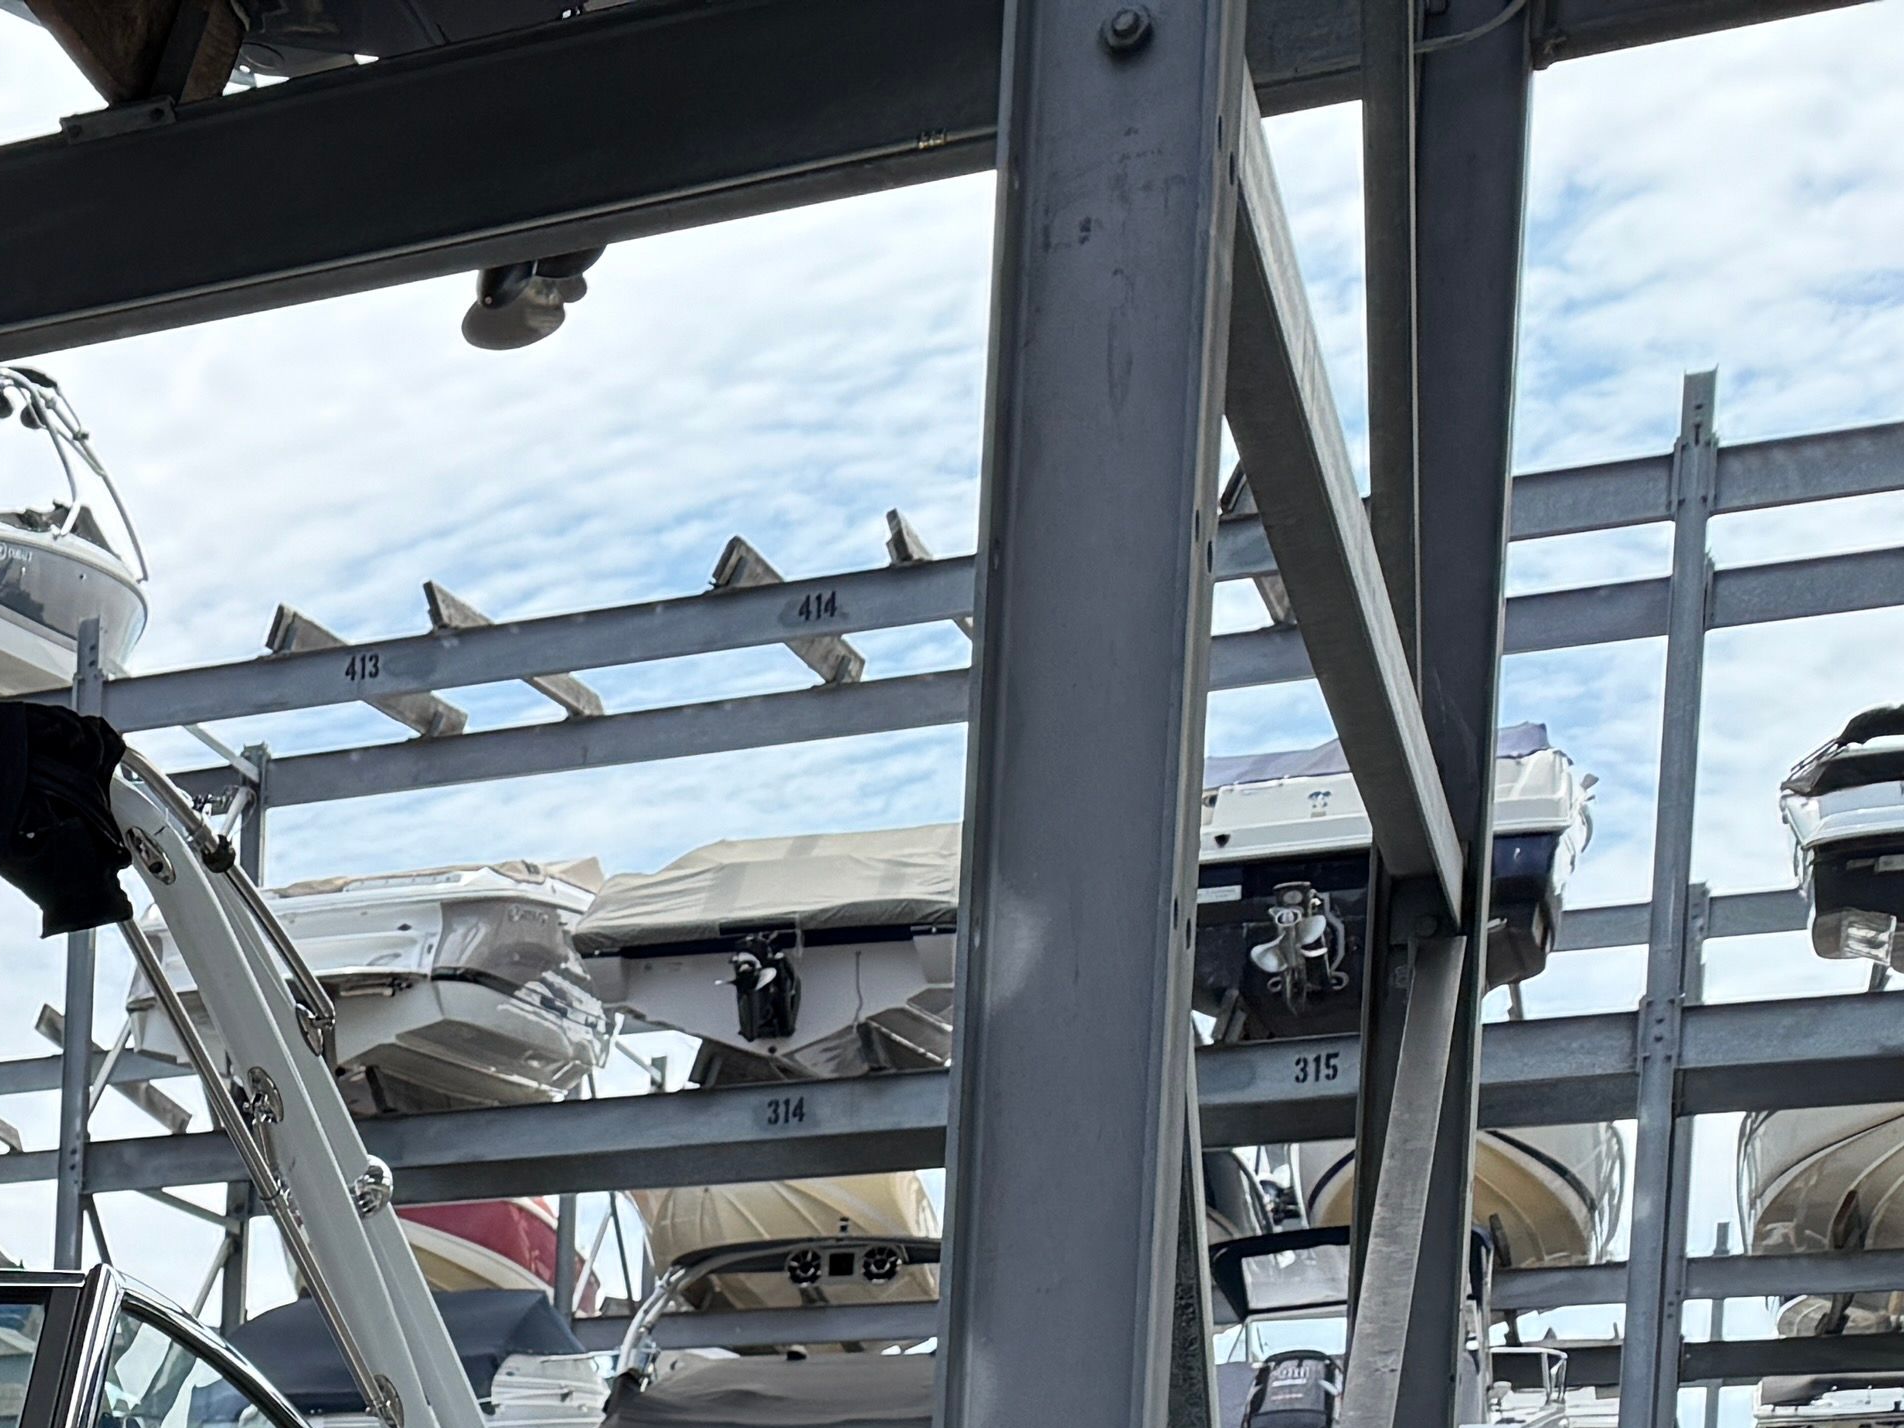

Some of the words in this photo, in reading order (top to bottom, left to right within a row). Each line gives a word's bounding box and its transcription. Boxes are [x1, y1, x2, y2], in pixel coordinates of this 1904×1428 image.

[797, 590, 837, 622] 414
[344, 651, 381, 682] 413
[1294, 1050, 1340, 1084] 315
[767, 1096, 806, 1125] 314
